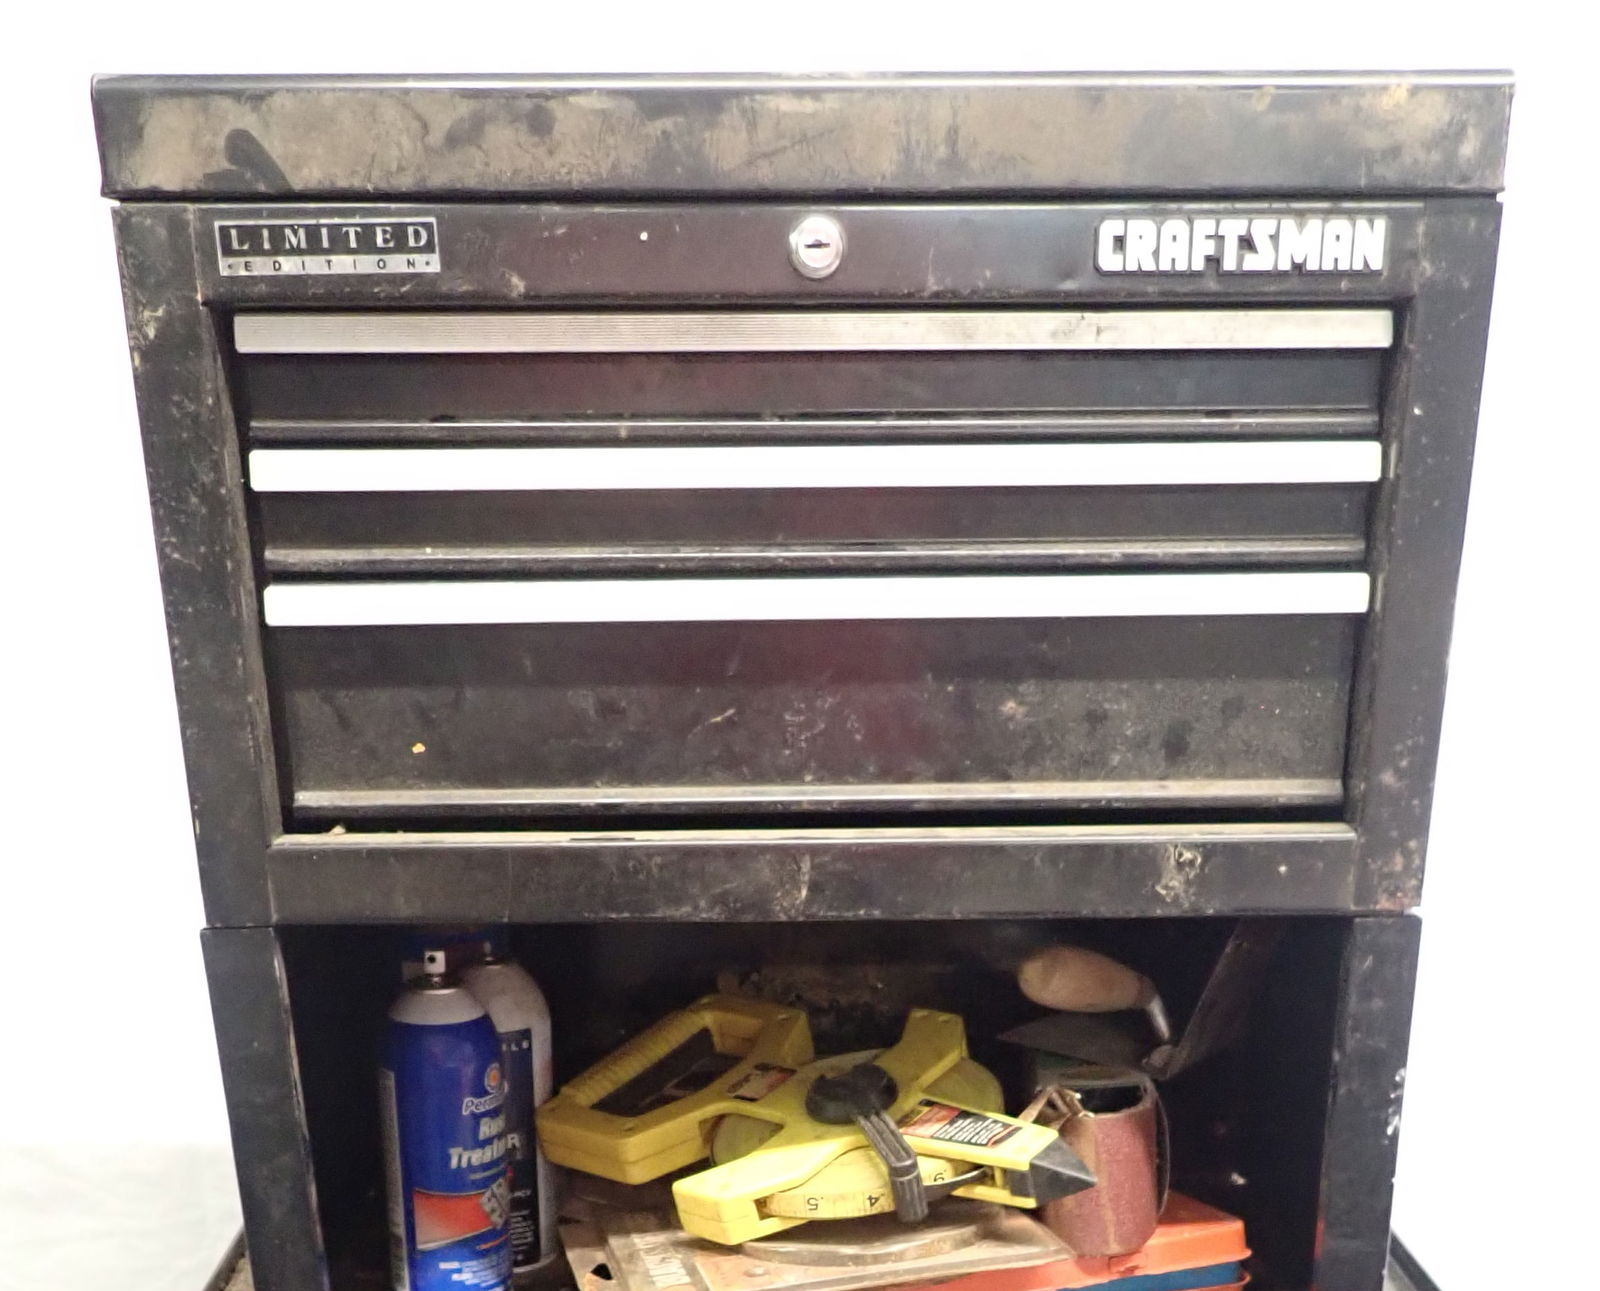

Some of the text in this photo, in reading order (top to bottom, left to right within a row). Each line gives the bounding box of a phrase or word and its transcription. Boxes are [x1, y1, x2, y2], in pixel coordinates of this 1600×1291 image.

[230, 224, 428, 250] LIMITED
[1097, 218, 1387, 272] CRAFTSMAN
[244, 258, 416, 272] EDITION
